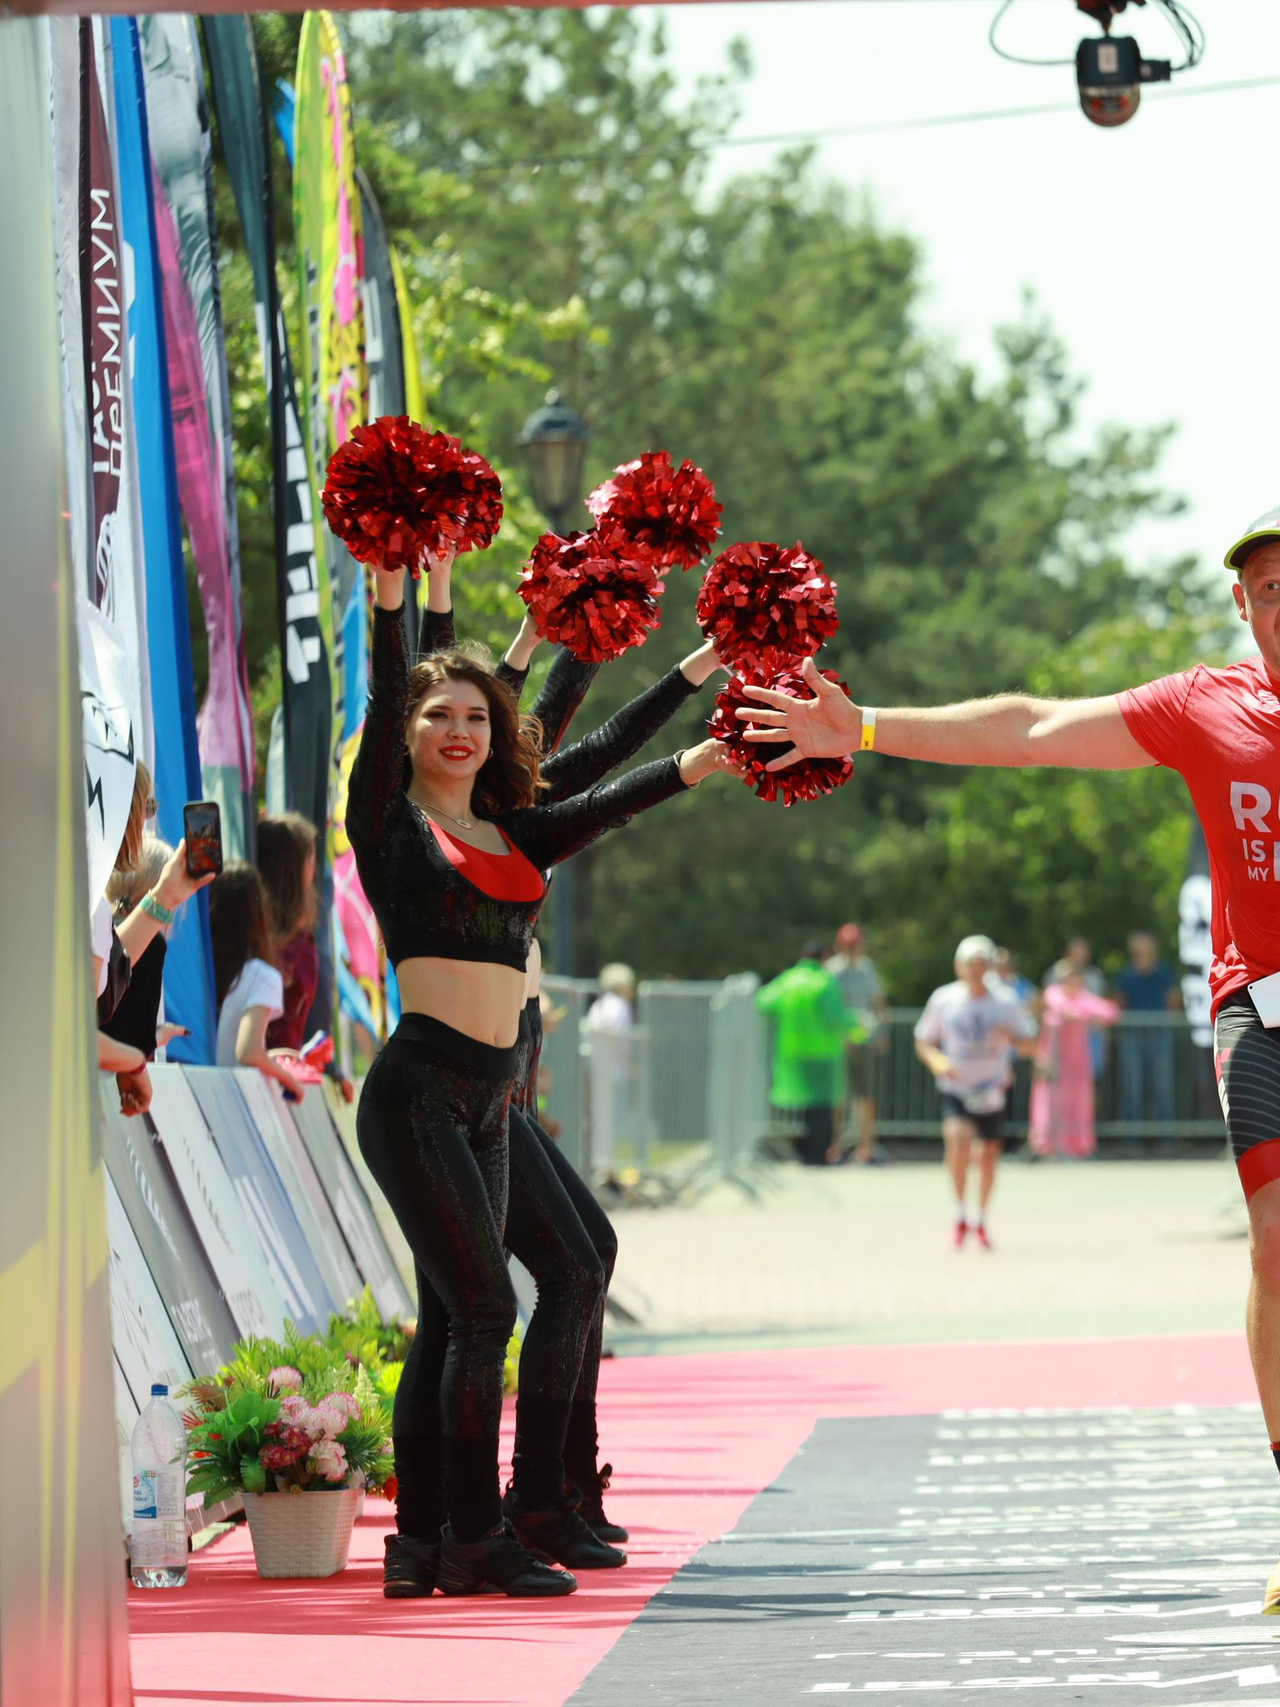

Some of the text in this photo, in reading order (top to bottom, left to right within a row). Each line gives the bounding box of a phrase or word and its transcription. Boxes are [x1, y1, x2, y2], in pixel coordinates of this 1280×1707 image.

[90, 188, 123, 478] ПРЕМИУМ
[1242, 838, 1266, 863] IS
[1247, 865, 1270, 882] MY
